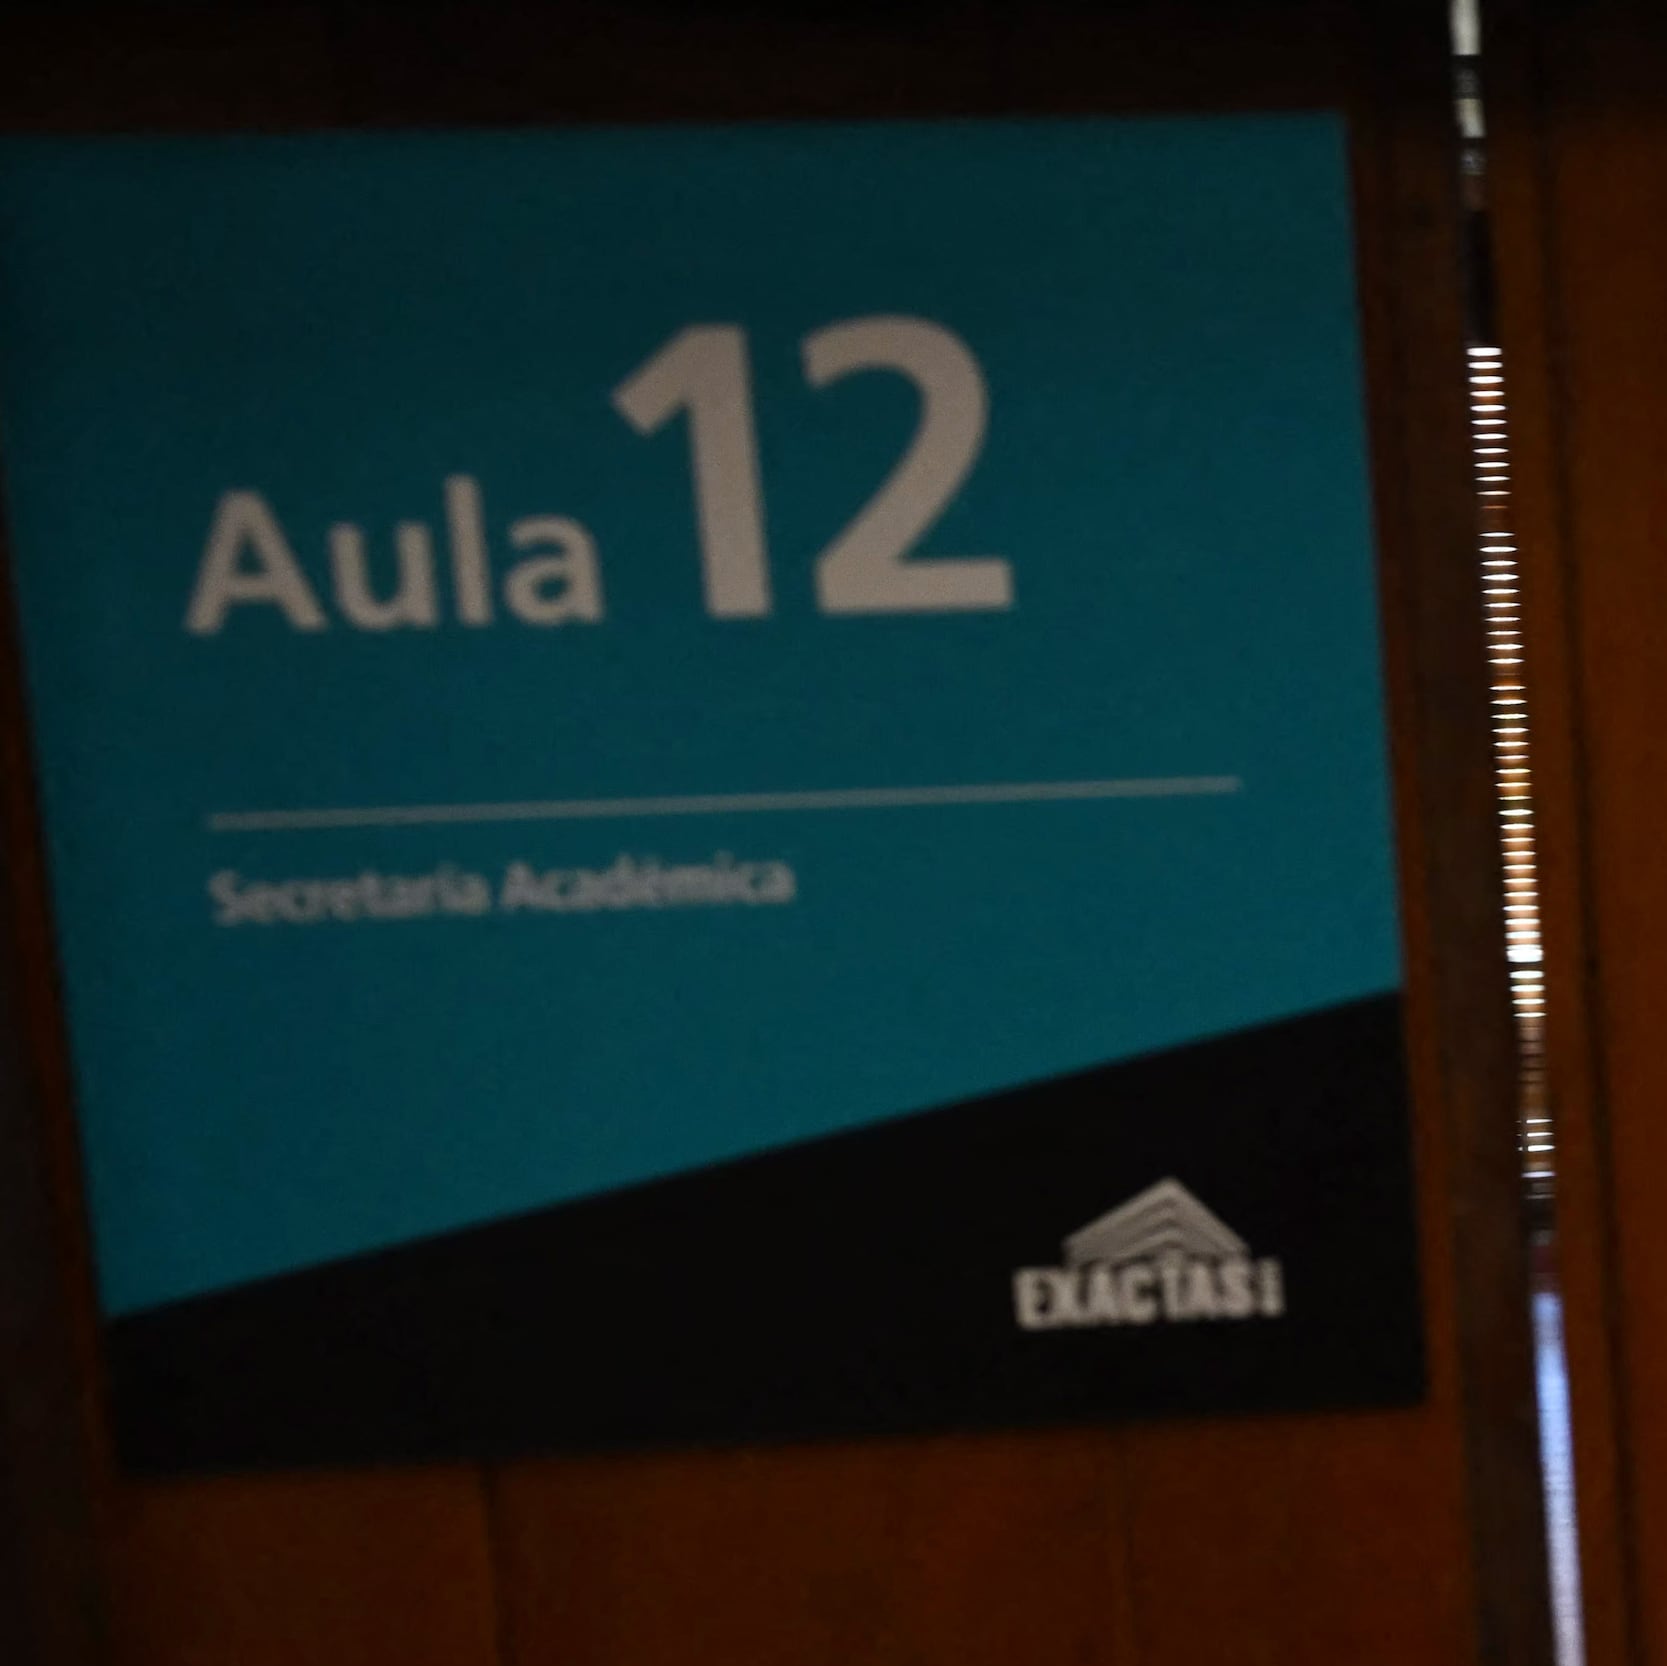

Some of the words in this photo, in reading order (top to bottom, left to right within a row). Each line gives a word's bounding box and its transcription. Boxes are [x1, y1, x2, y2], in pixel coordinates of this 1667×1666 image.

[185, 475, 605, 634] Aula
[612, 313, 1013, 618] 12
[206, 864, 492, 927] Secretaría
[503, 850, 797, 914] Académica
